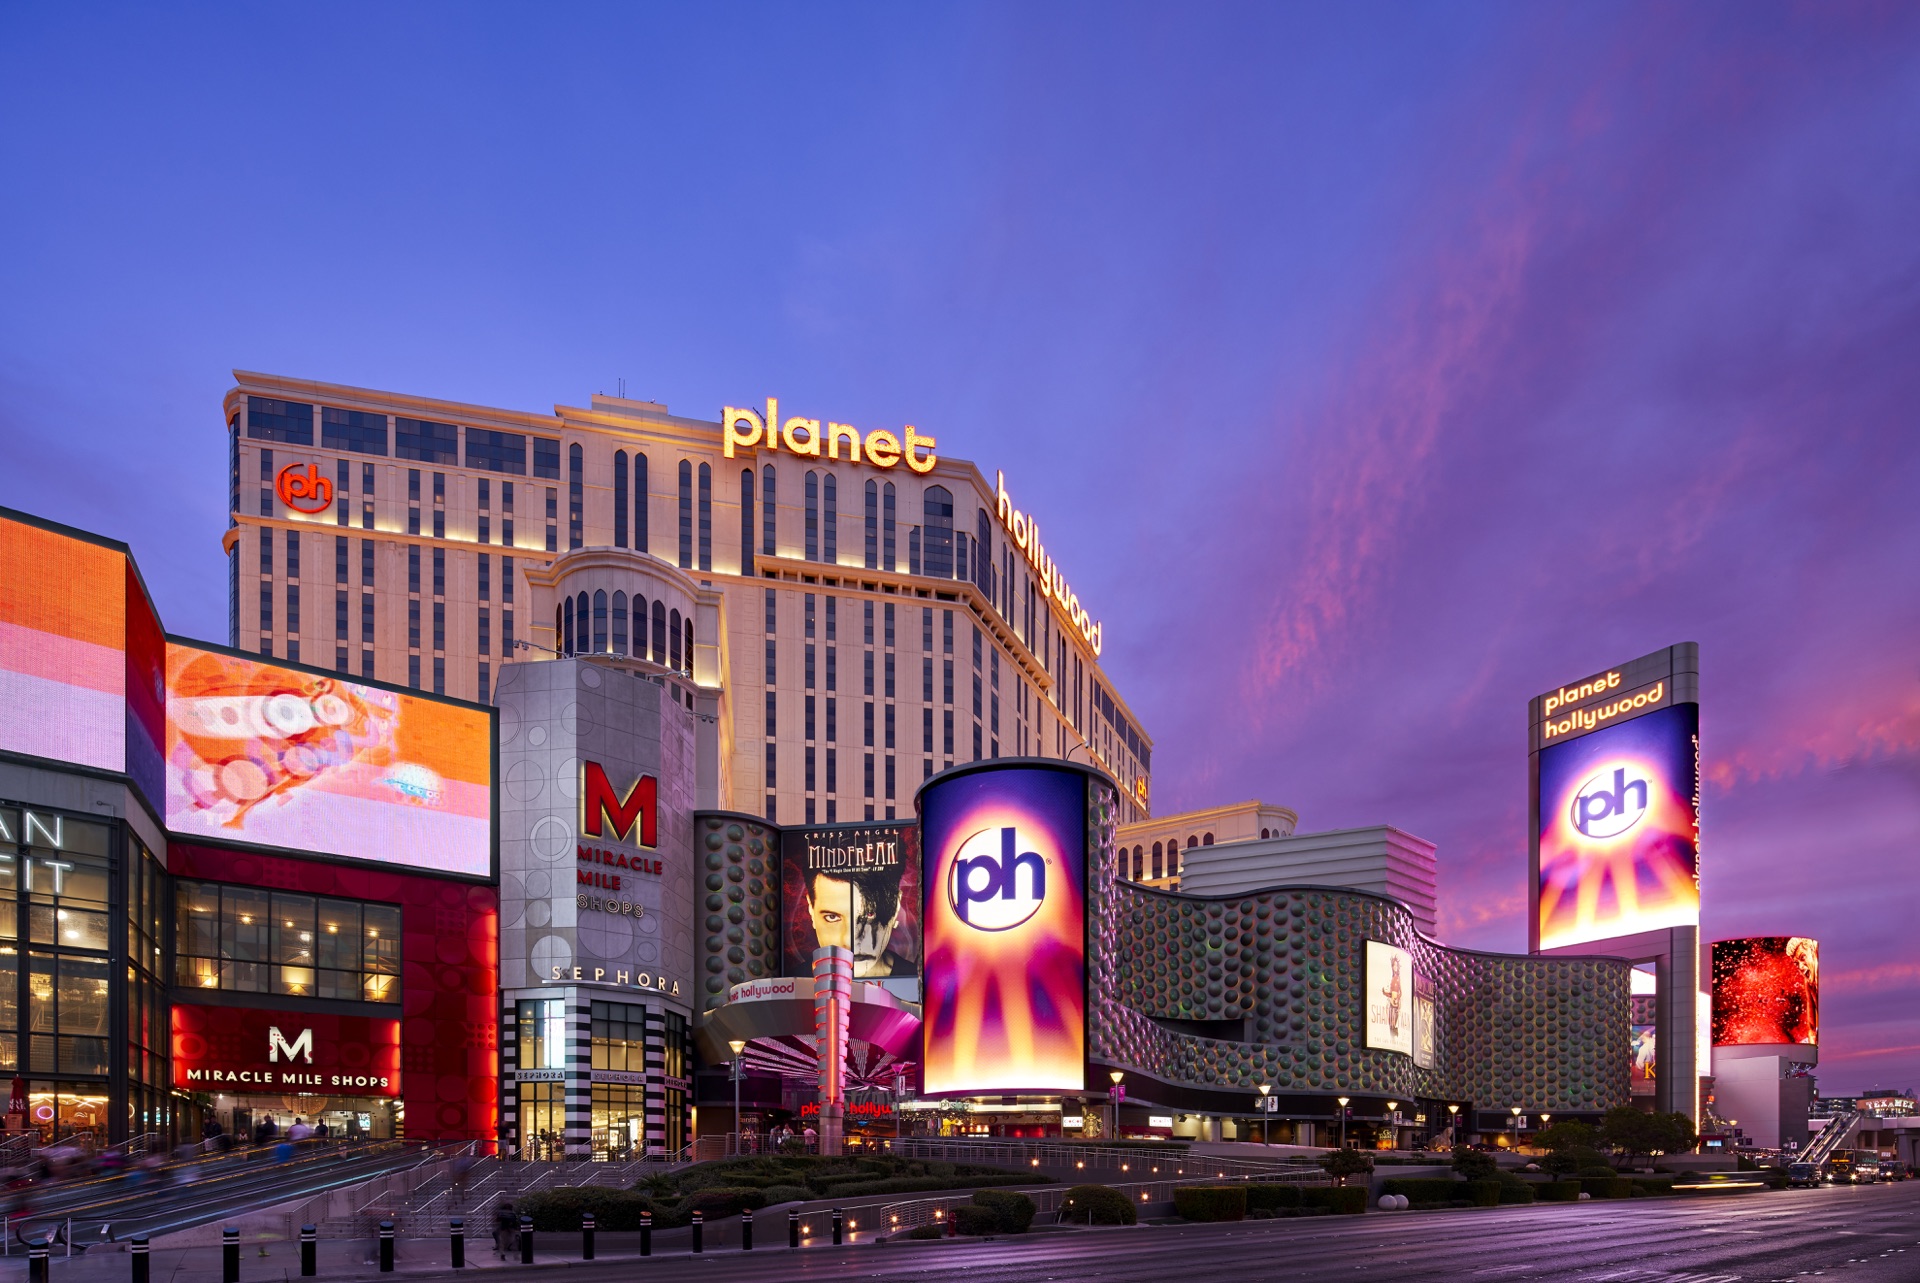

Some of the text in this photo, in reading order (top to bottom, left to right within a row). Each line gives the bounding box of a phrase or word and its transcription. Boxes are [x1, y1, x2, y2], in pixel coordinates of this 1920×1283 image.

[723, 398, 937, 474] planet
[282, 464, 333, 504] ph
[997, 470, 1102, 657] hollywood
[1544, 671, 1621, 716] planet
[1545, 681, 1663, 740] hollywood
[584, 760, 658, 848] M
[1578, 767, 1648, 836] ph
[804, 828, 899, 840] CRISS ANGEL
[577, 844, 662, 876] MIRACLE
[957, 827, 1046, 922] ph
[577, 868, 621, 891] MILE
[577, 893, 644, 919] SHOPS
[552, 965, 680, 995] SEPHORA
[741, 982, 795, 999] hollywood
[269, 1026, 312, 1063] M
[187, 1069, 389, 1088] MIRACLE MILE SHOPS
[517, 1072, 564, 1080] SEPHORA
[594, 1072, 644, 1082] SEPHORA
